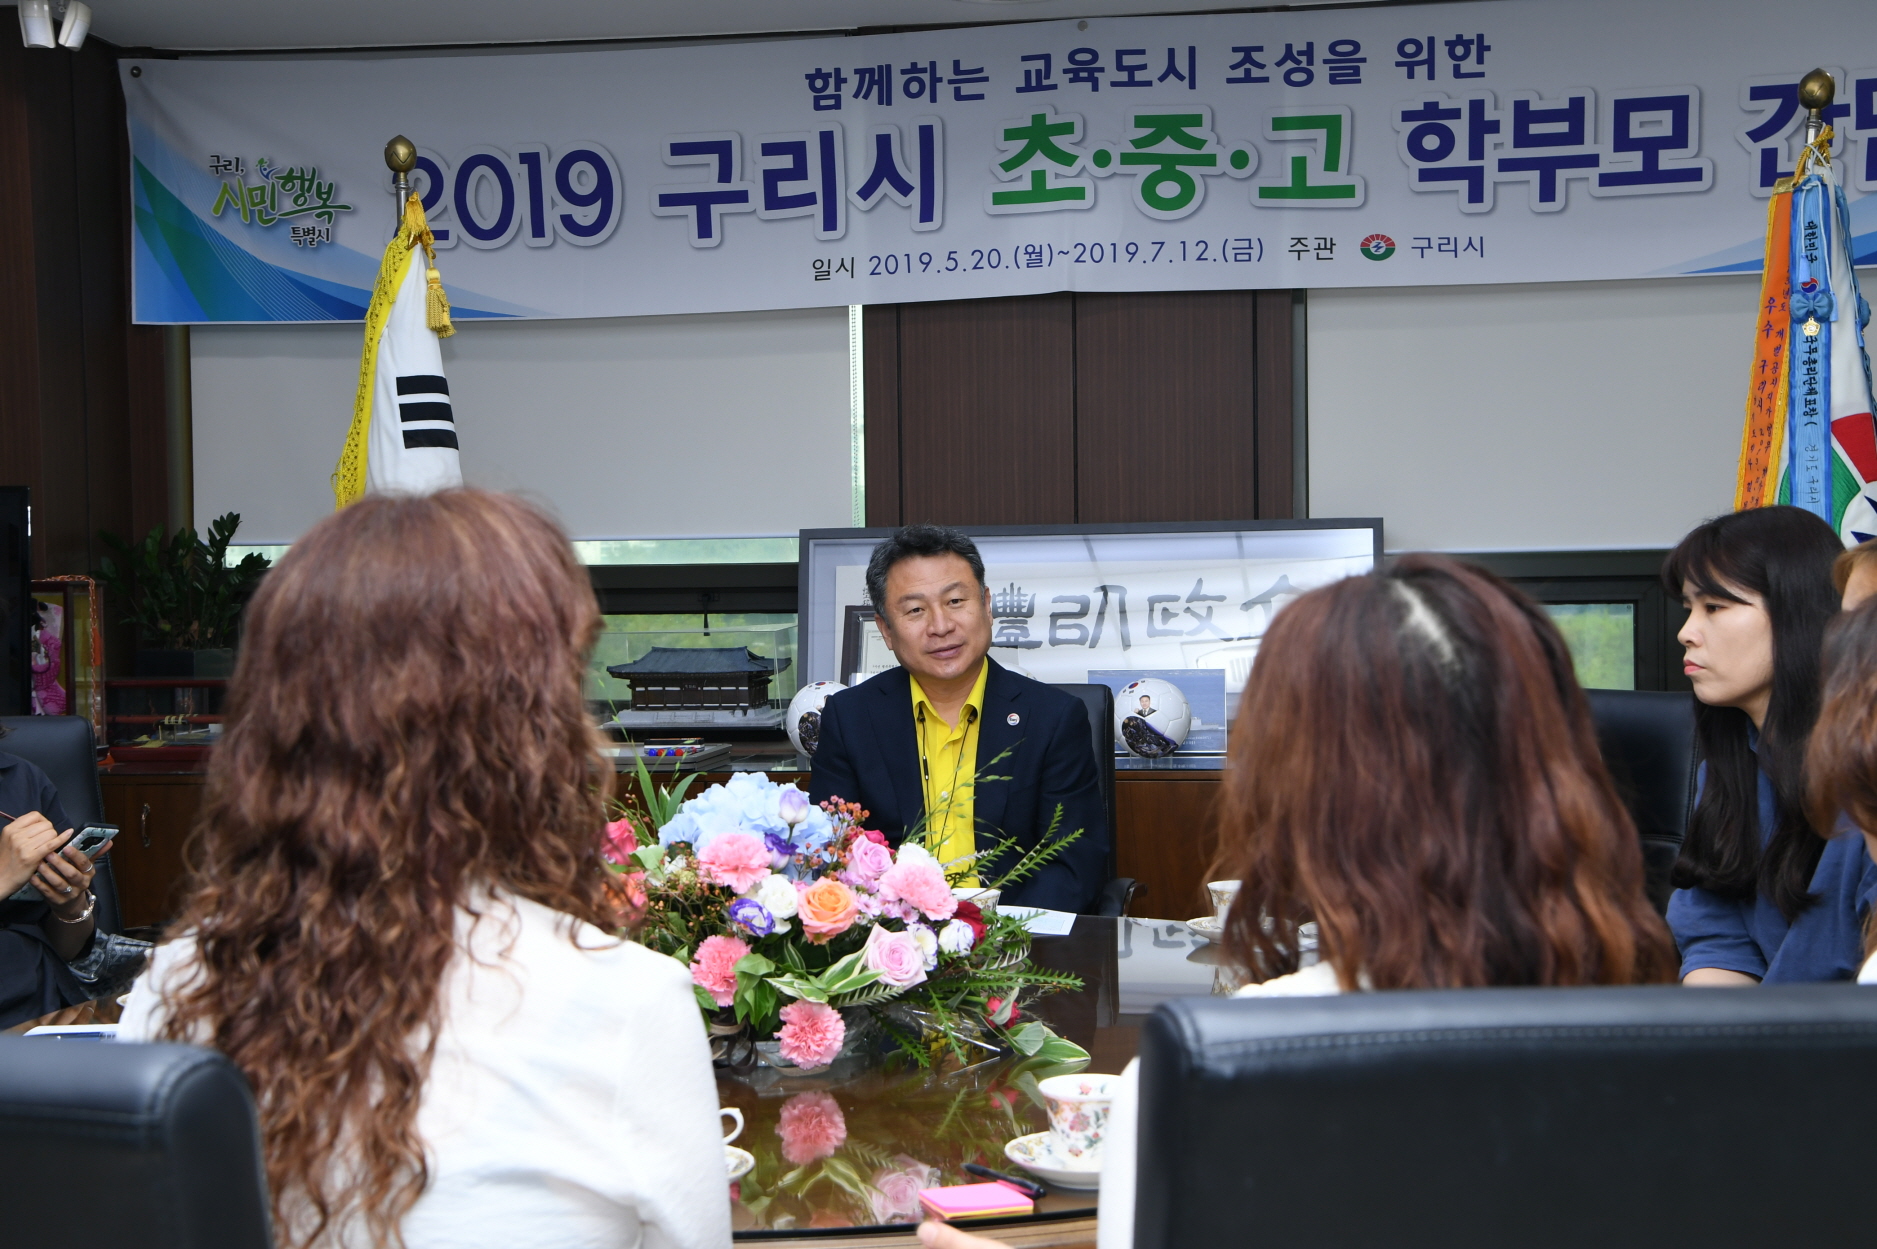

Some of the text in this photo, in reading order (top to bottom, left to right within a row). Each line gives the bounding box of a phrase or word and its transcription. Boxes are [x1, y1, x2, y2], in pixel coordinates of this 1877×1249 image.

[805, 33, 1492, 112] 함께하는 교육도시 조성을 위한
[209, 154, 245, 176] 구리,
[392, 149, 614, 241] 2019
[658, 124, 936, 240] 구리시
[1400, 94, 1705, 204] 학부모
[1744, 77, 1877, 188] 간
[290, 226, 330, 247] 특별시
[1804, 220, 1818, 264] 대한민국
[1288, 237, 1486, 262] 주관 구리시
[812, 257, 856, 282] 일시
